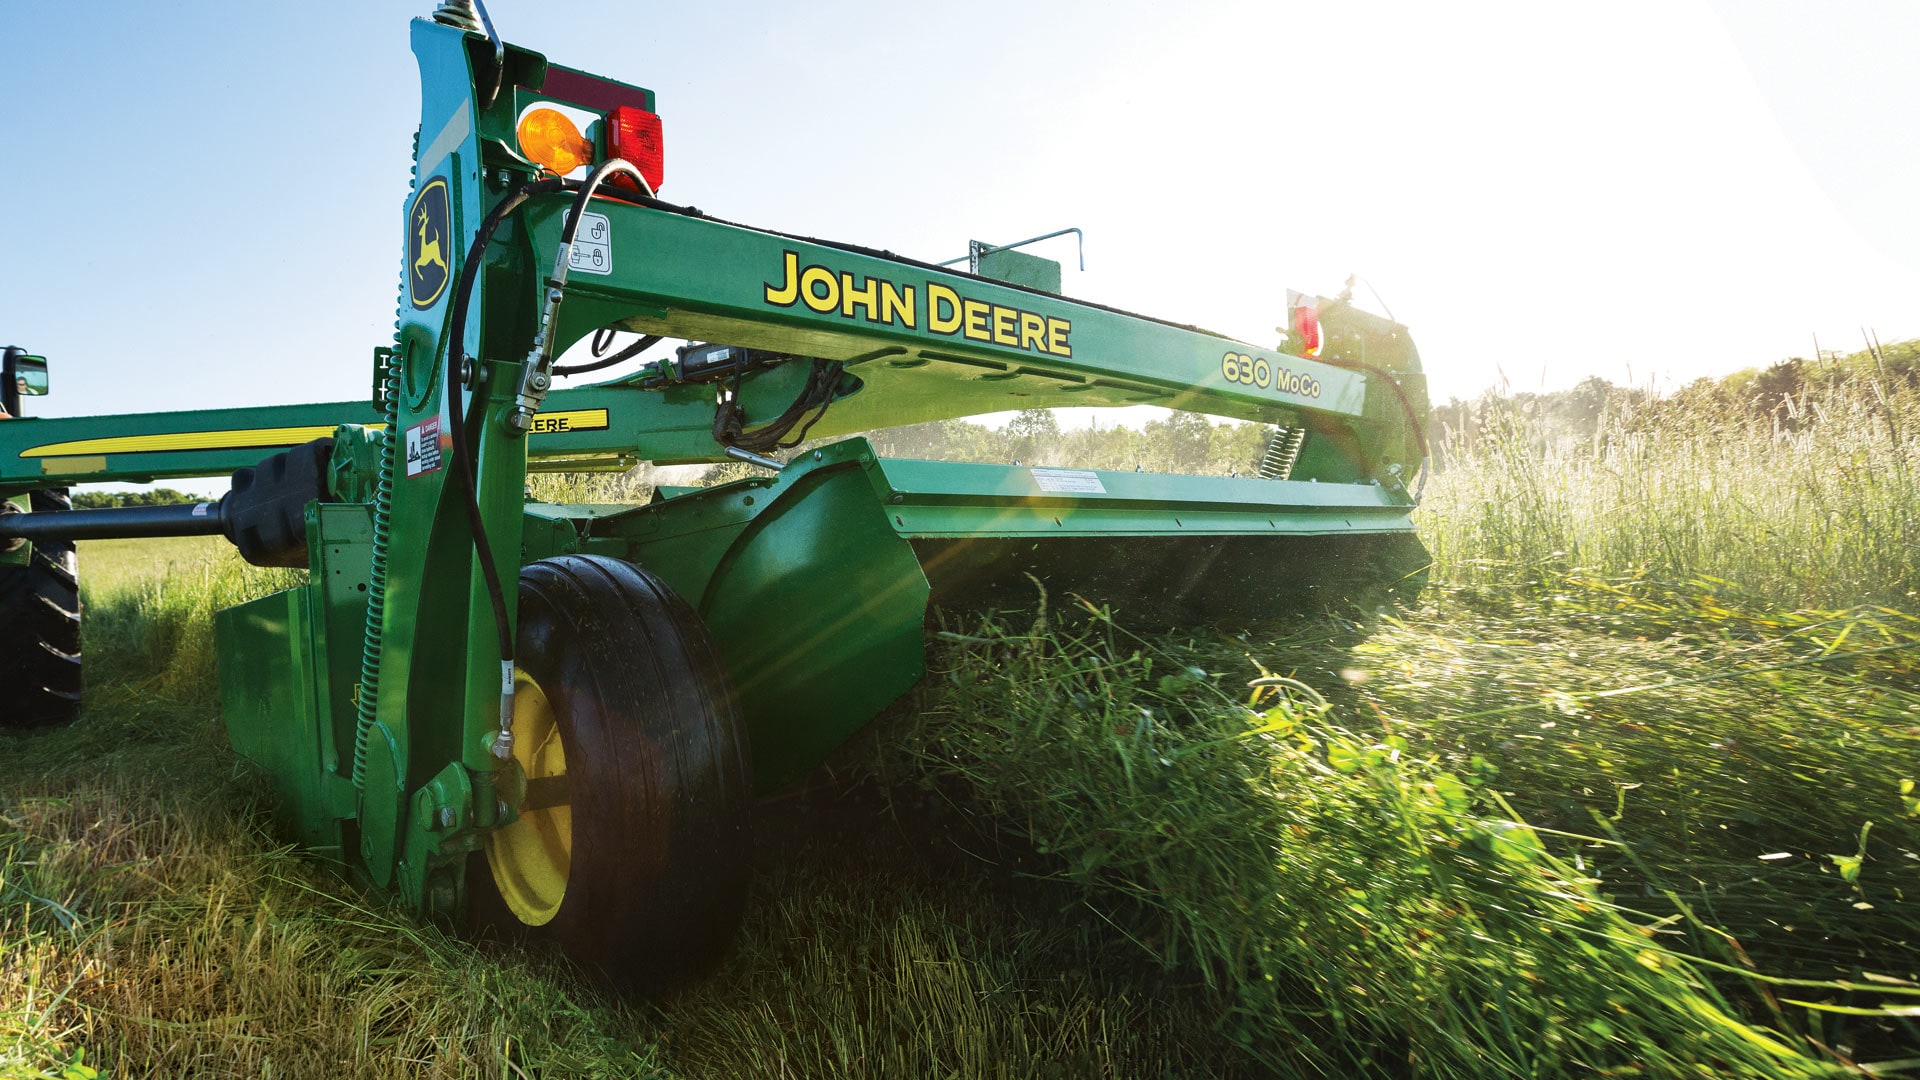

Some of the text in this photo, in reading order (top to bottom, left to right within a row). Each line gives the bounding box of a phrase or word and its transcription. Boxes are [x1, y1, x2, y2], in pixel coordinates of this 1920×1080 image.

[764, 250, 1072, 358] JOHN DEERE
[1222, 351, 1321, 398] 630 MoCo
